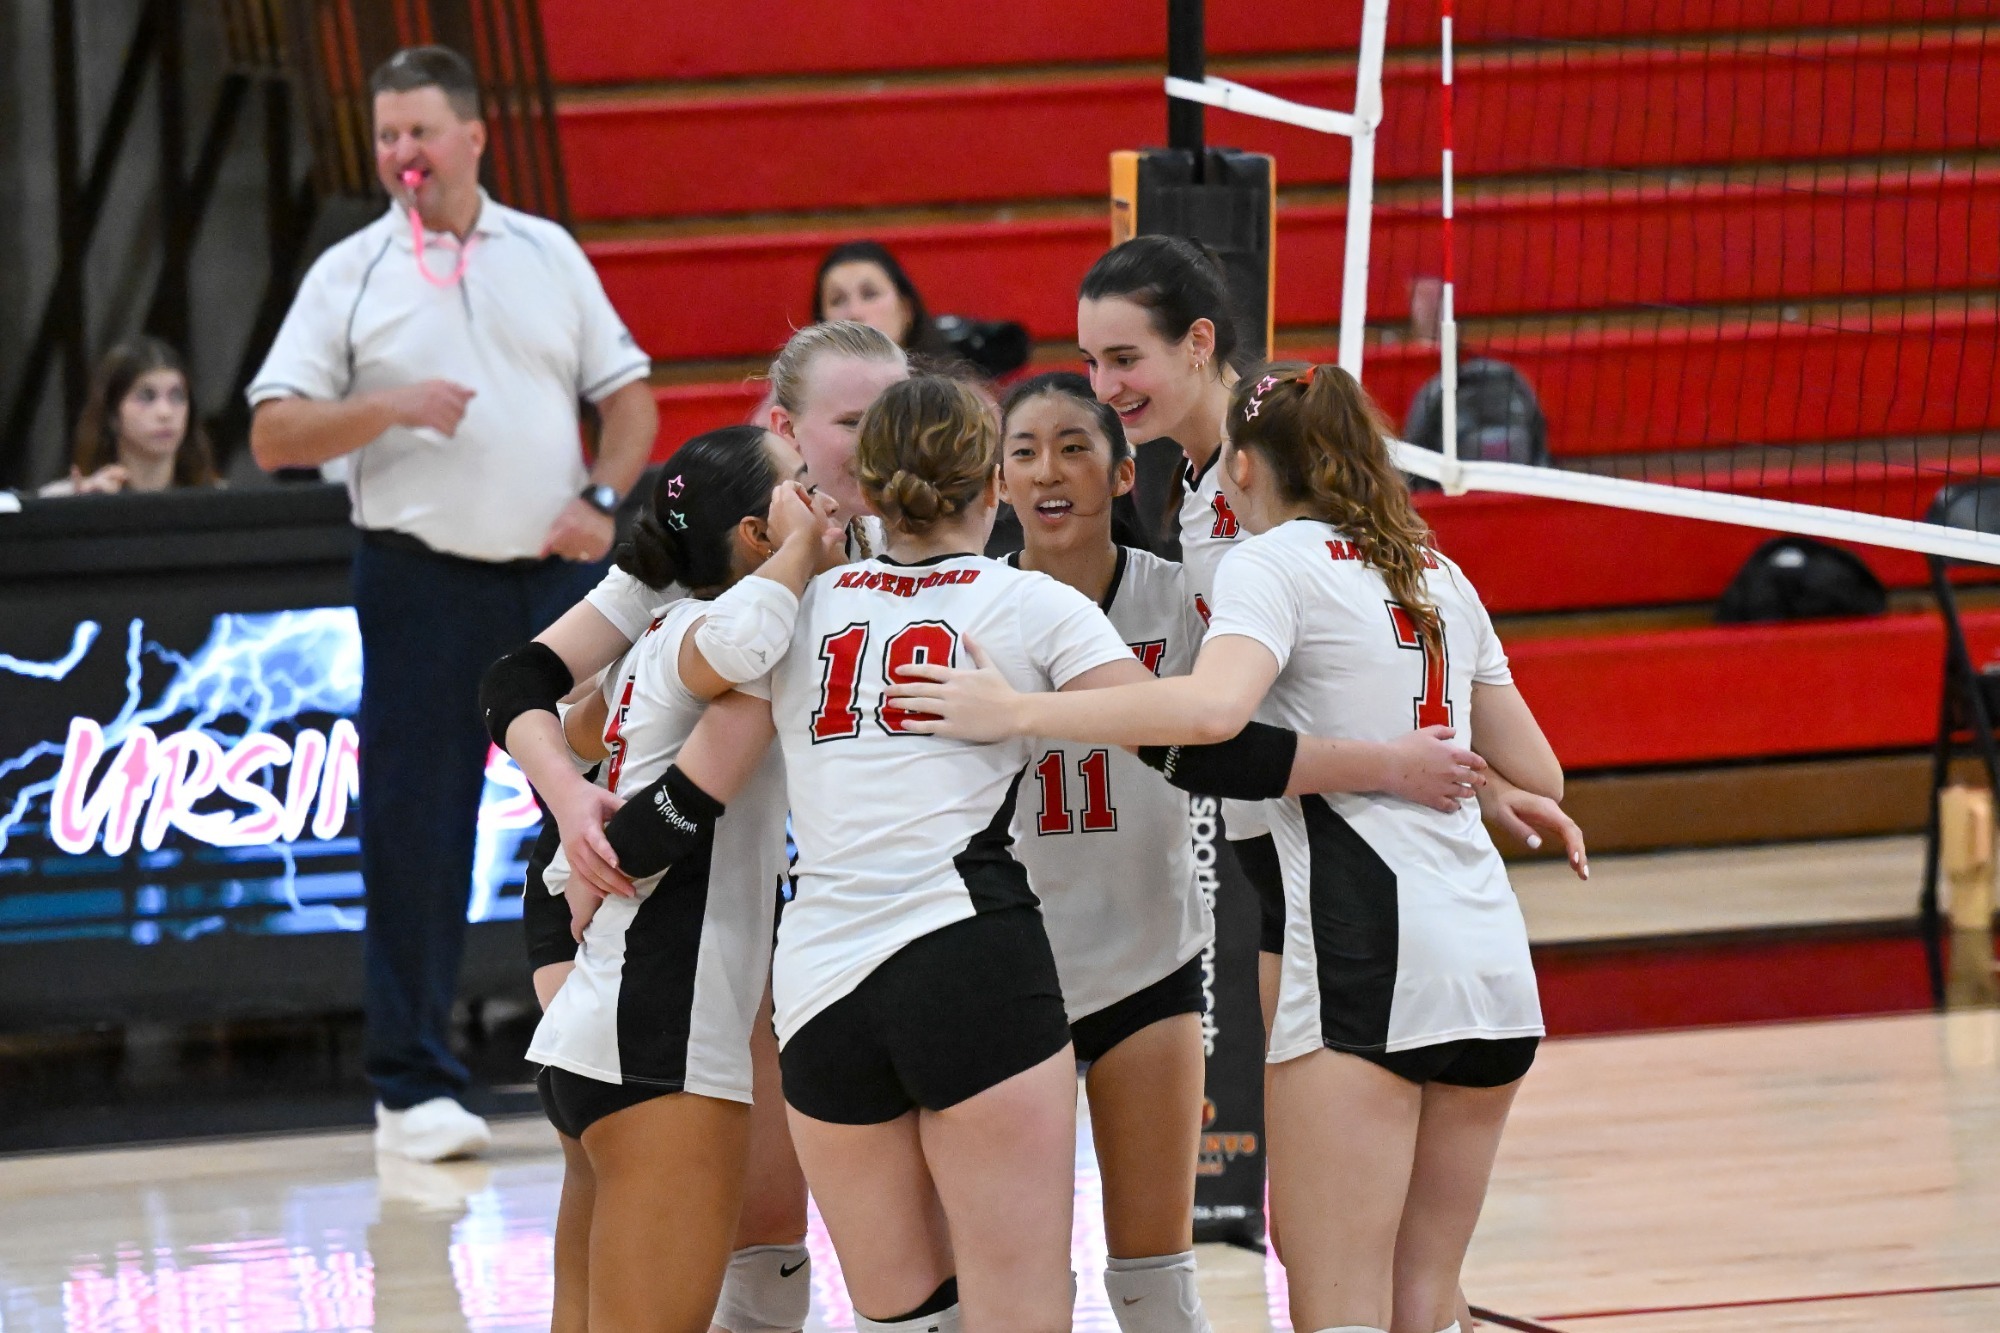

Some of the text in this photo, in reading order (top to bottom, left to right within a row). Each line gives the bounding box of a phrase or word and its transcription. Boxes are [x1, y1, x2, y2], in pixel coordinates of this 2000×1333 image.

[832, 569, 981, 598] HAVERFORD
[1384, 599, 1454, 738] 7
[657, 784, 698, 833] Tandem
[1035, 749, 1118, 837] 11
